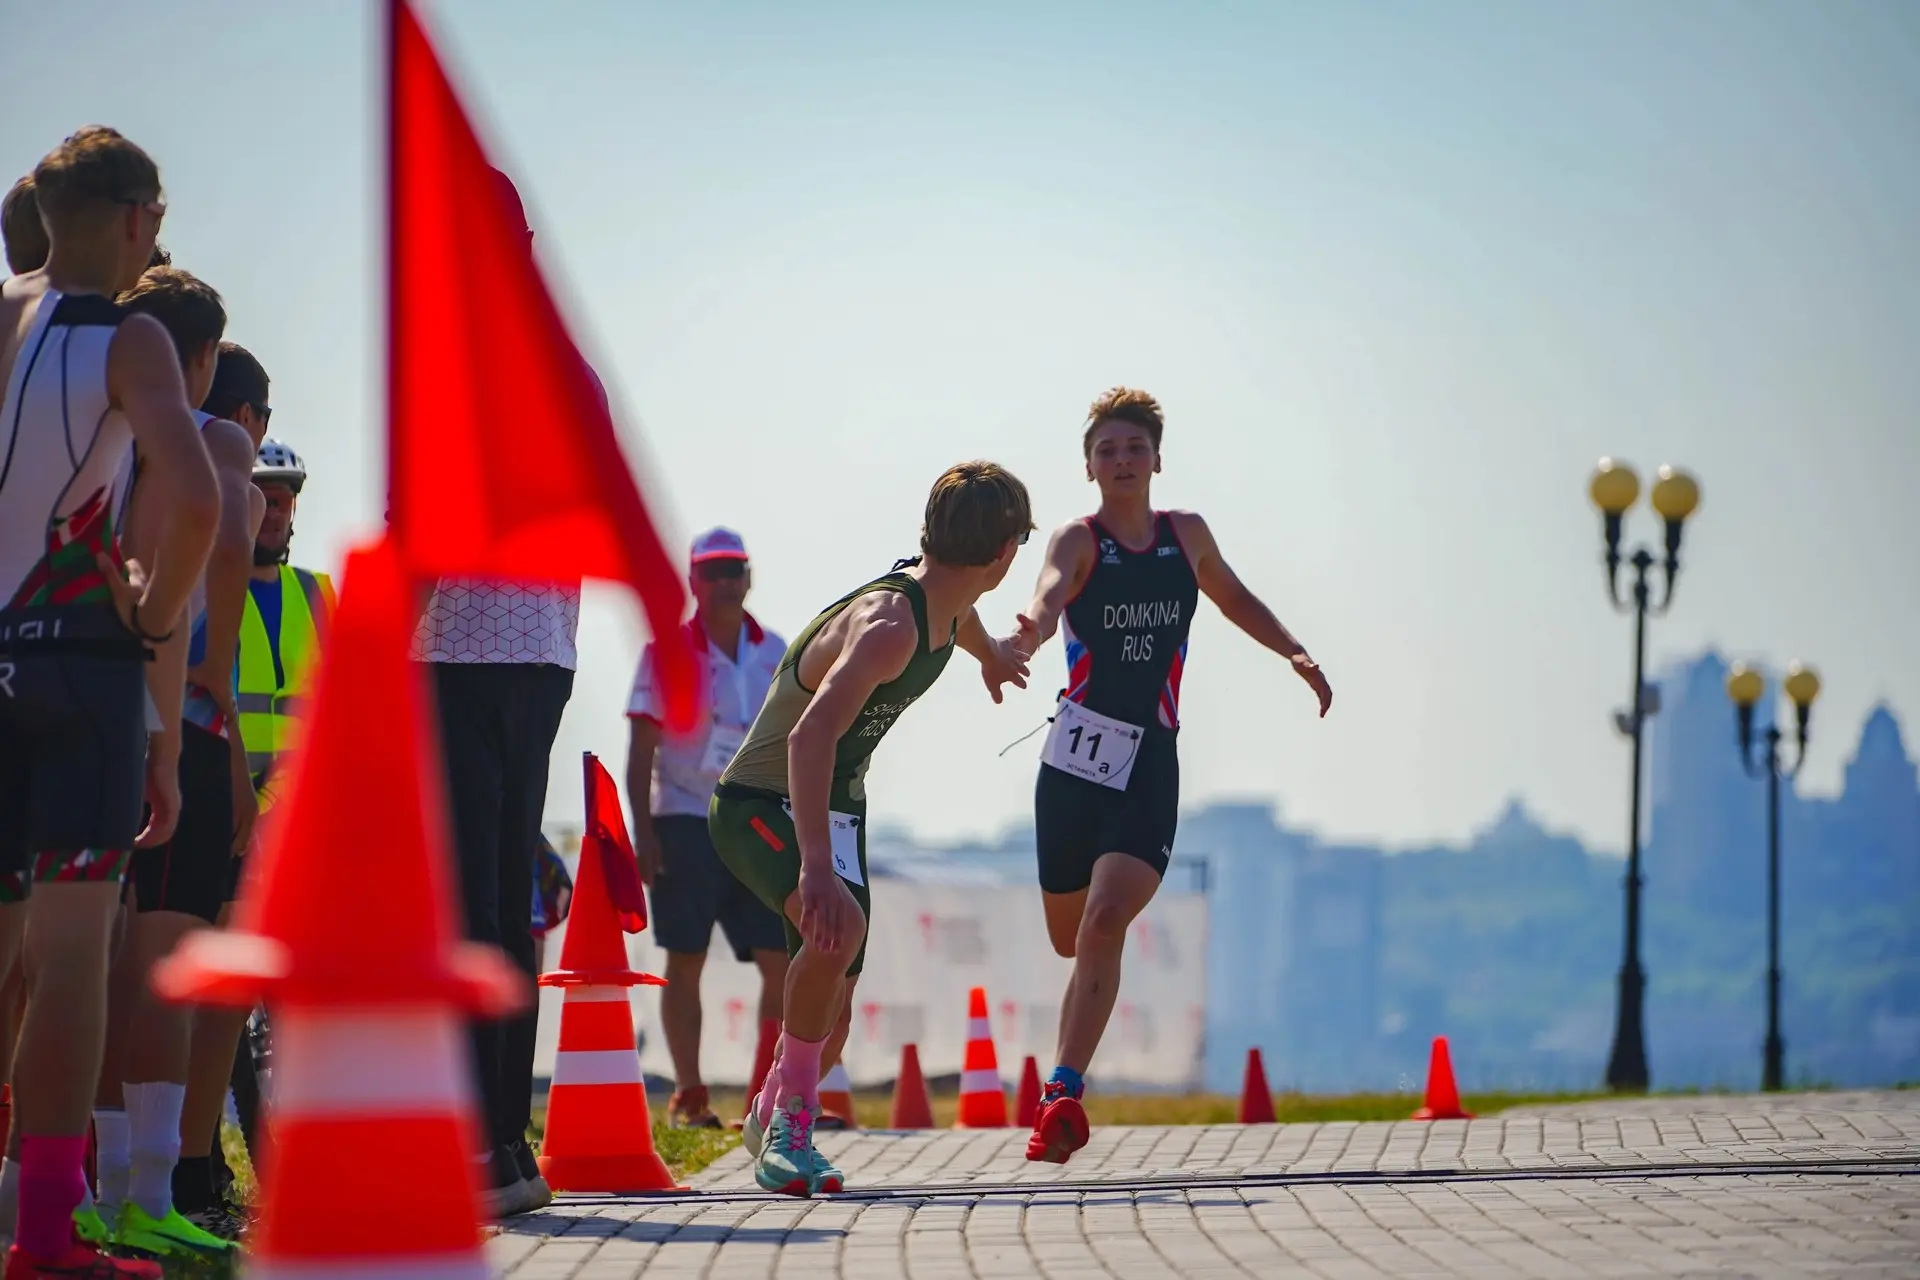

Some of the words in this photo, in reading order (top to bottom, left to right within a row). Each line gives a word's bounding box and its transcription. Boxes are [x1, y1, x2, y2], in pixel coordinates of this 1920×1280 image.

[1103, 600, 1180, 629] DOMKINA
[1121, 634, 1154, 662] RUS
[857, 717, 891, 737] RUS
[1068, 725, 1103, 762] 11
